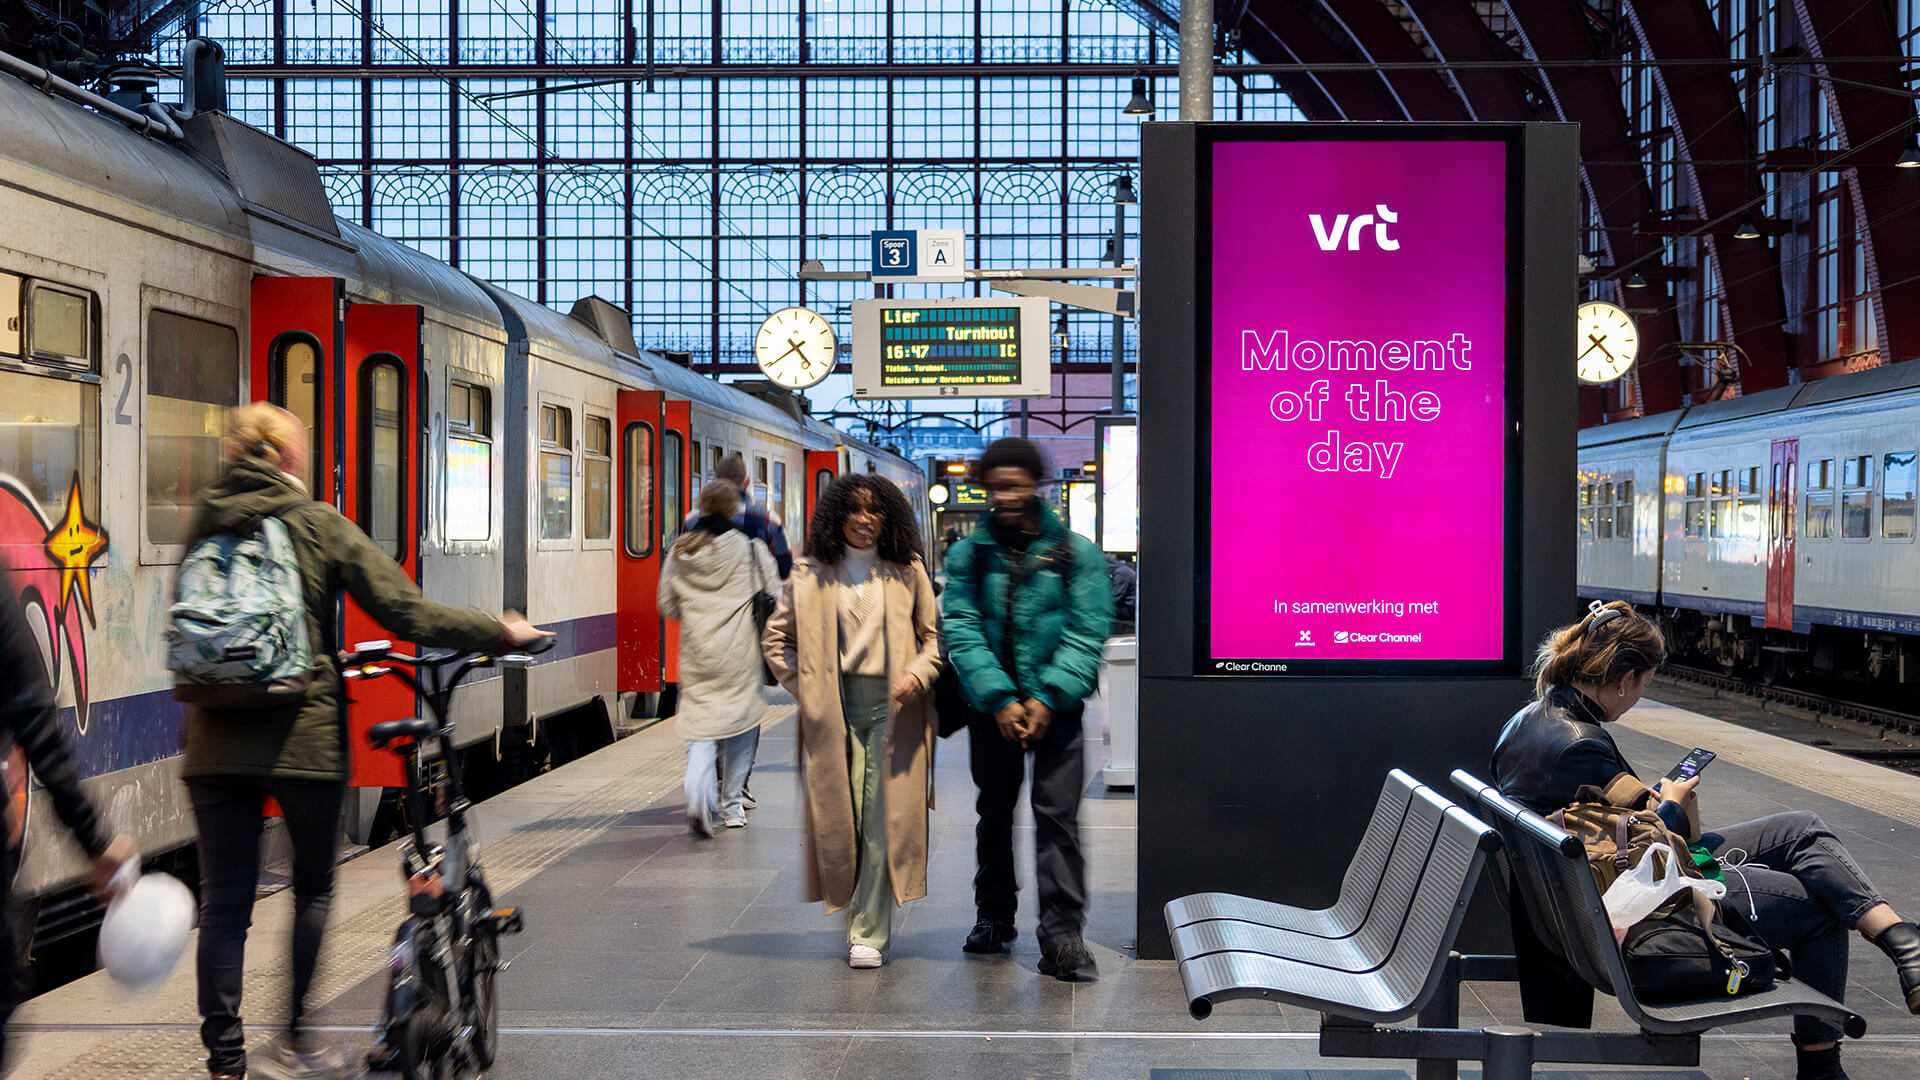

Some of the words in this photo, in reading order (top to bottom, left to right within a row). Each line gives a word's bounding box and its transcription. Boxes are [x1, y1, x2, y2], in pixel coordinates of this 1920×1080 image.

[1308, 204, 1400, 252] vrt
[883, 241, 905, 249] Spoor
[888, 249, 900, 265] 3
[934, 249, 947, 264] A
[884, 309, 920, 323] Lier
[945, 326, 1015, 340] Turnhout
[886, 344, 930, 359] 16:47
[999, 343, 1017, 358] IC
[1241, 330, 1472, 371] Moment
[115, 352, 132, 425] 2
[1270, 380, 1329, 422] of
[1345, 380, 1441, 422] the
[1307, 430, 1404, 479] day
[1274, 599, 1287, 613] In
[1292, 599, 1404, 617] samenwerking
[1408, 600, 1439, 614] met
[1350, 632, 1377, 642] Clear
[1379, 632, 1422, 643] Channel
[1225, 661, 1250, 671] Clear
